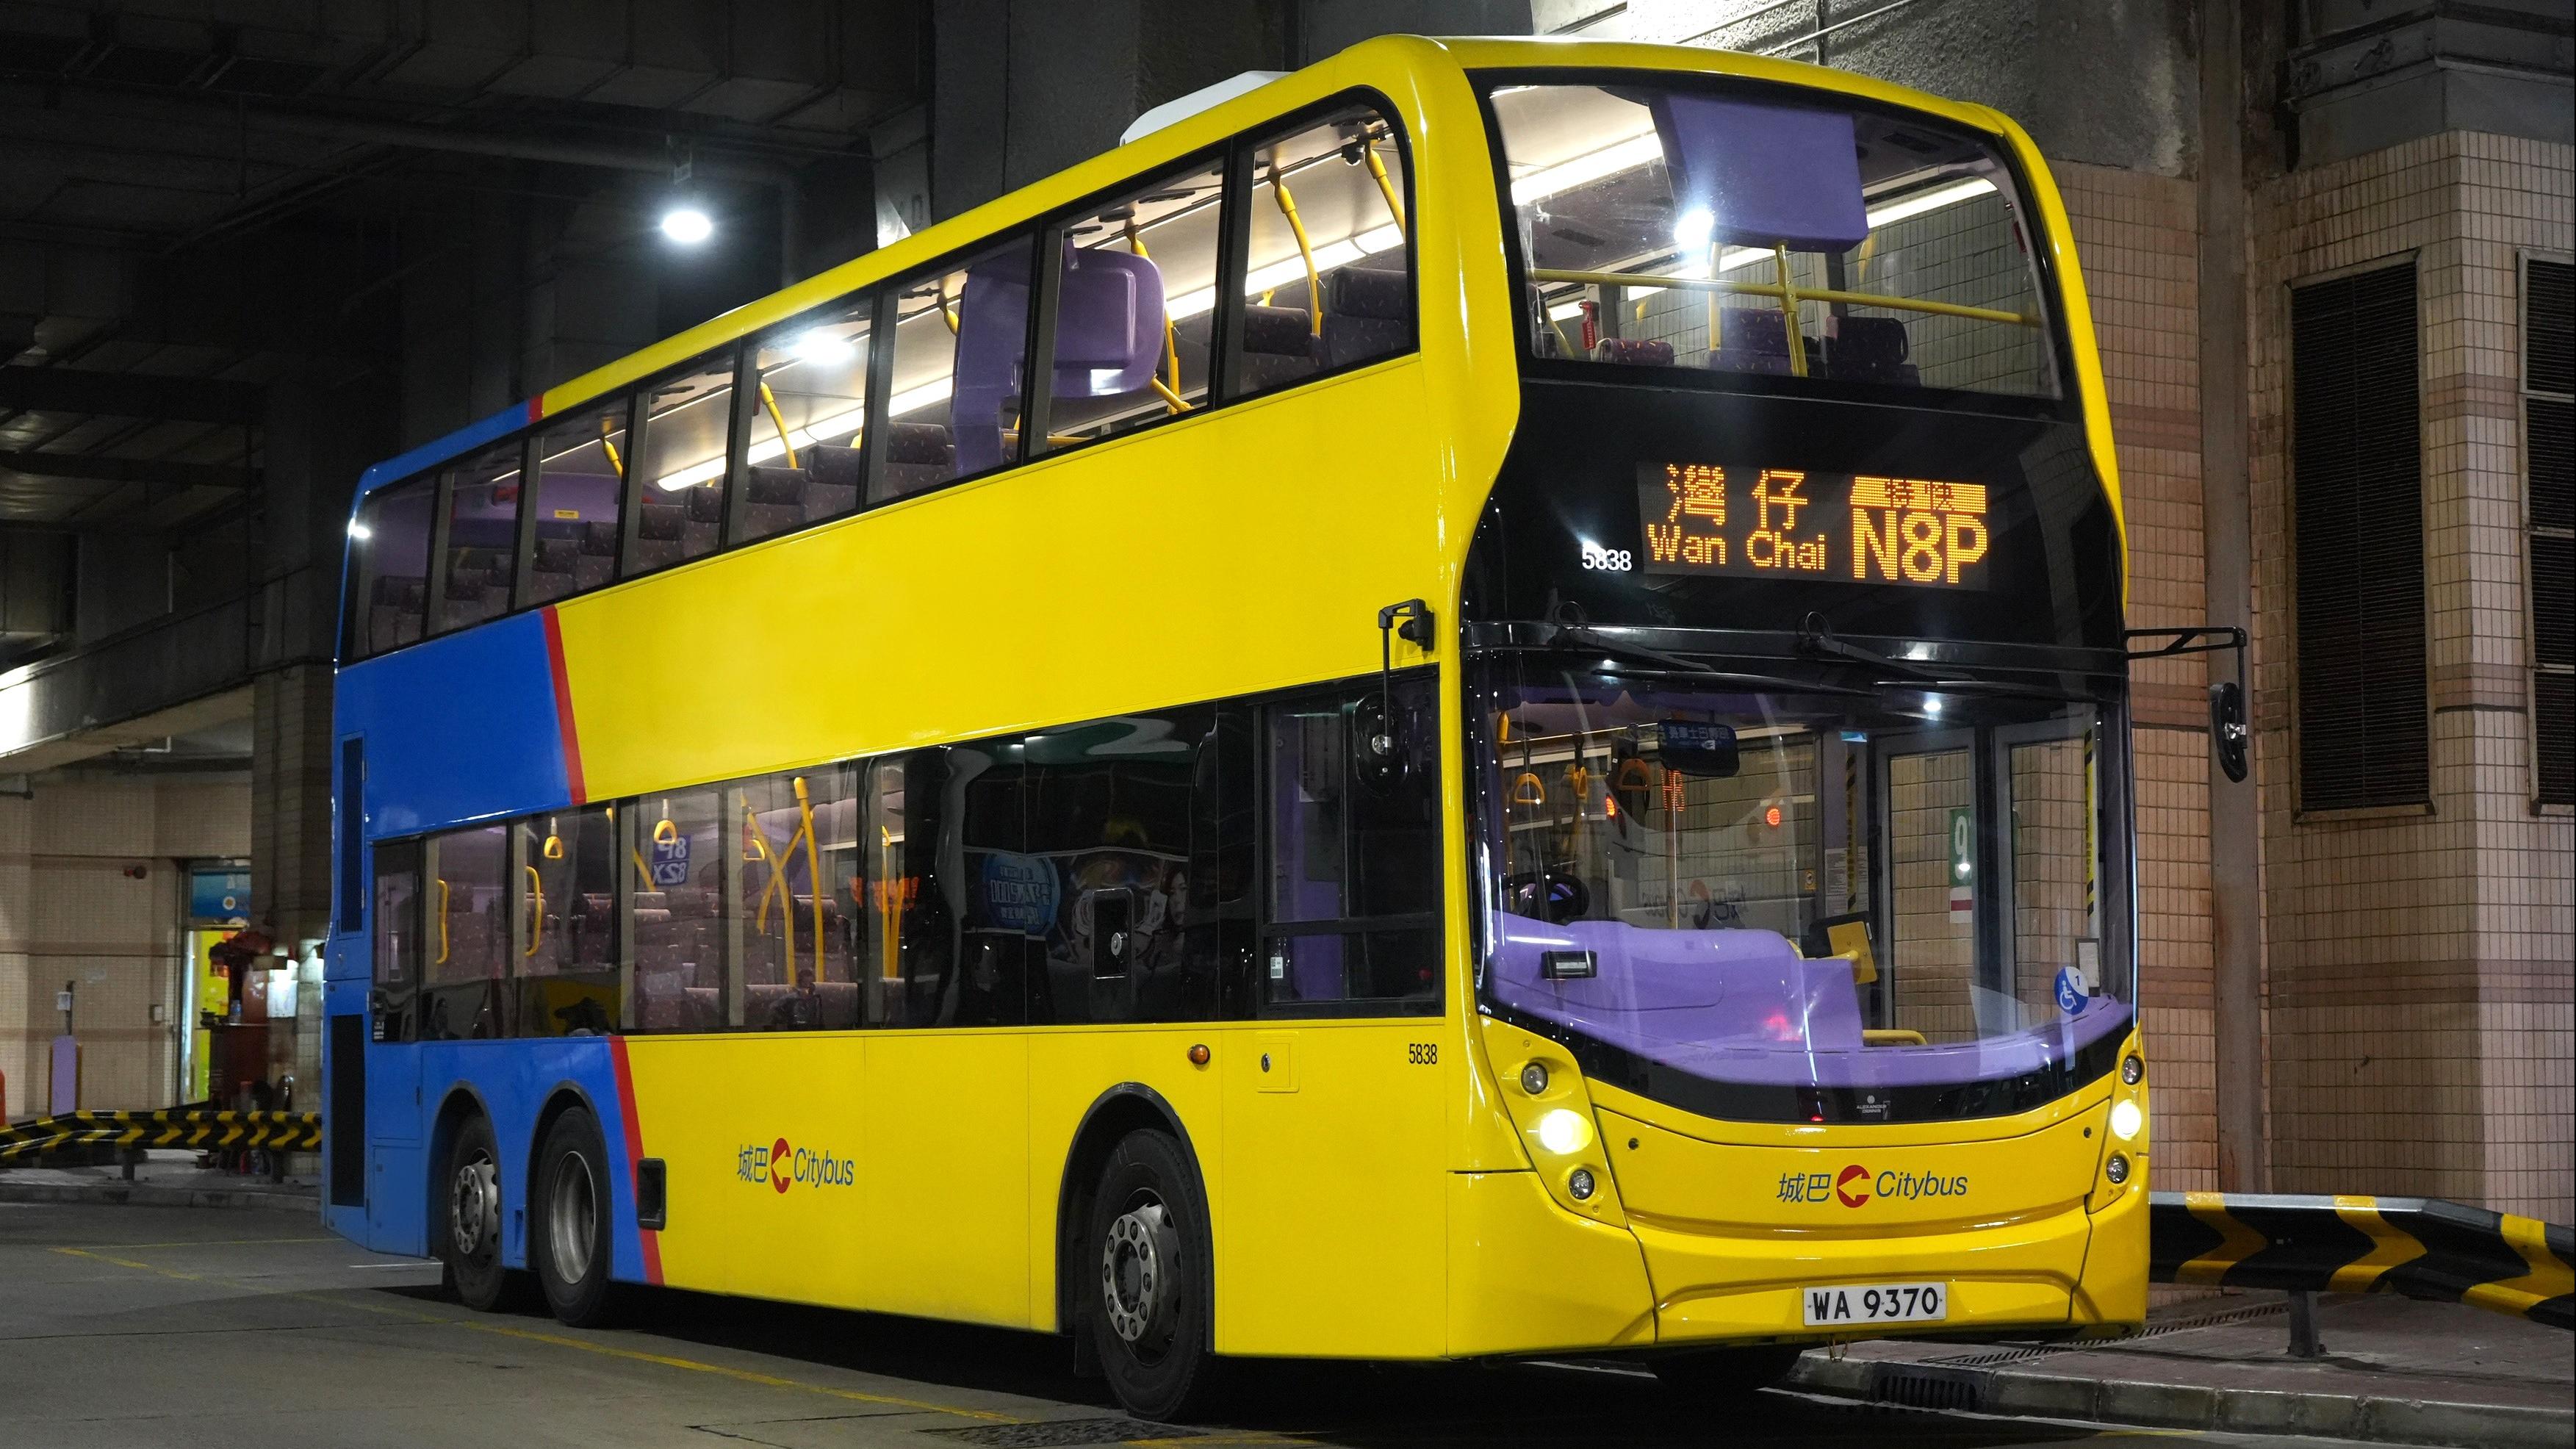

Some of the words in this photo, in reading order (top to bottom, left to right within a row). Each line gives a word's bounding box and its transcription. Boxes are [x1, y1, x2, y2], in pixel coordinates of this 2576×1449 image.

[1666, 464, 1808, 530] 灣仔
[1885, 479, 1956, 510] 特快
[1582, 542, 1632, 571] 5838
[1647, 523, 1726, 564] Wan
[1746, 530, 1826, 570] Chai
[1852, 508, 1987, 583] N8P
[2075, 975, 2080, 986] 1
[1408, 1043, 1438, 1065] 5838
[737, 1144, 769, 1183] 城巴
[794, 1147, 855, 1188] Citybus
[1776, 1172, 1832, 1203] 城巴
[1876, 1171, 1968, 1201] Citybus
[1813, 1290, 1851, 1320] WA
[1863, 1287, 1938, 1318] 9370
